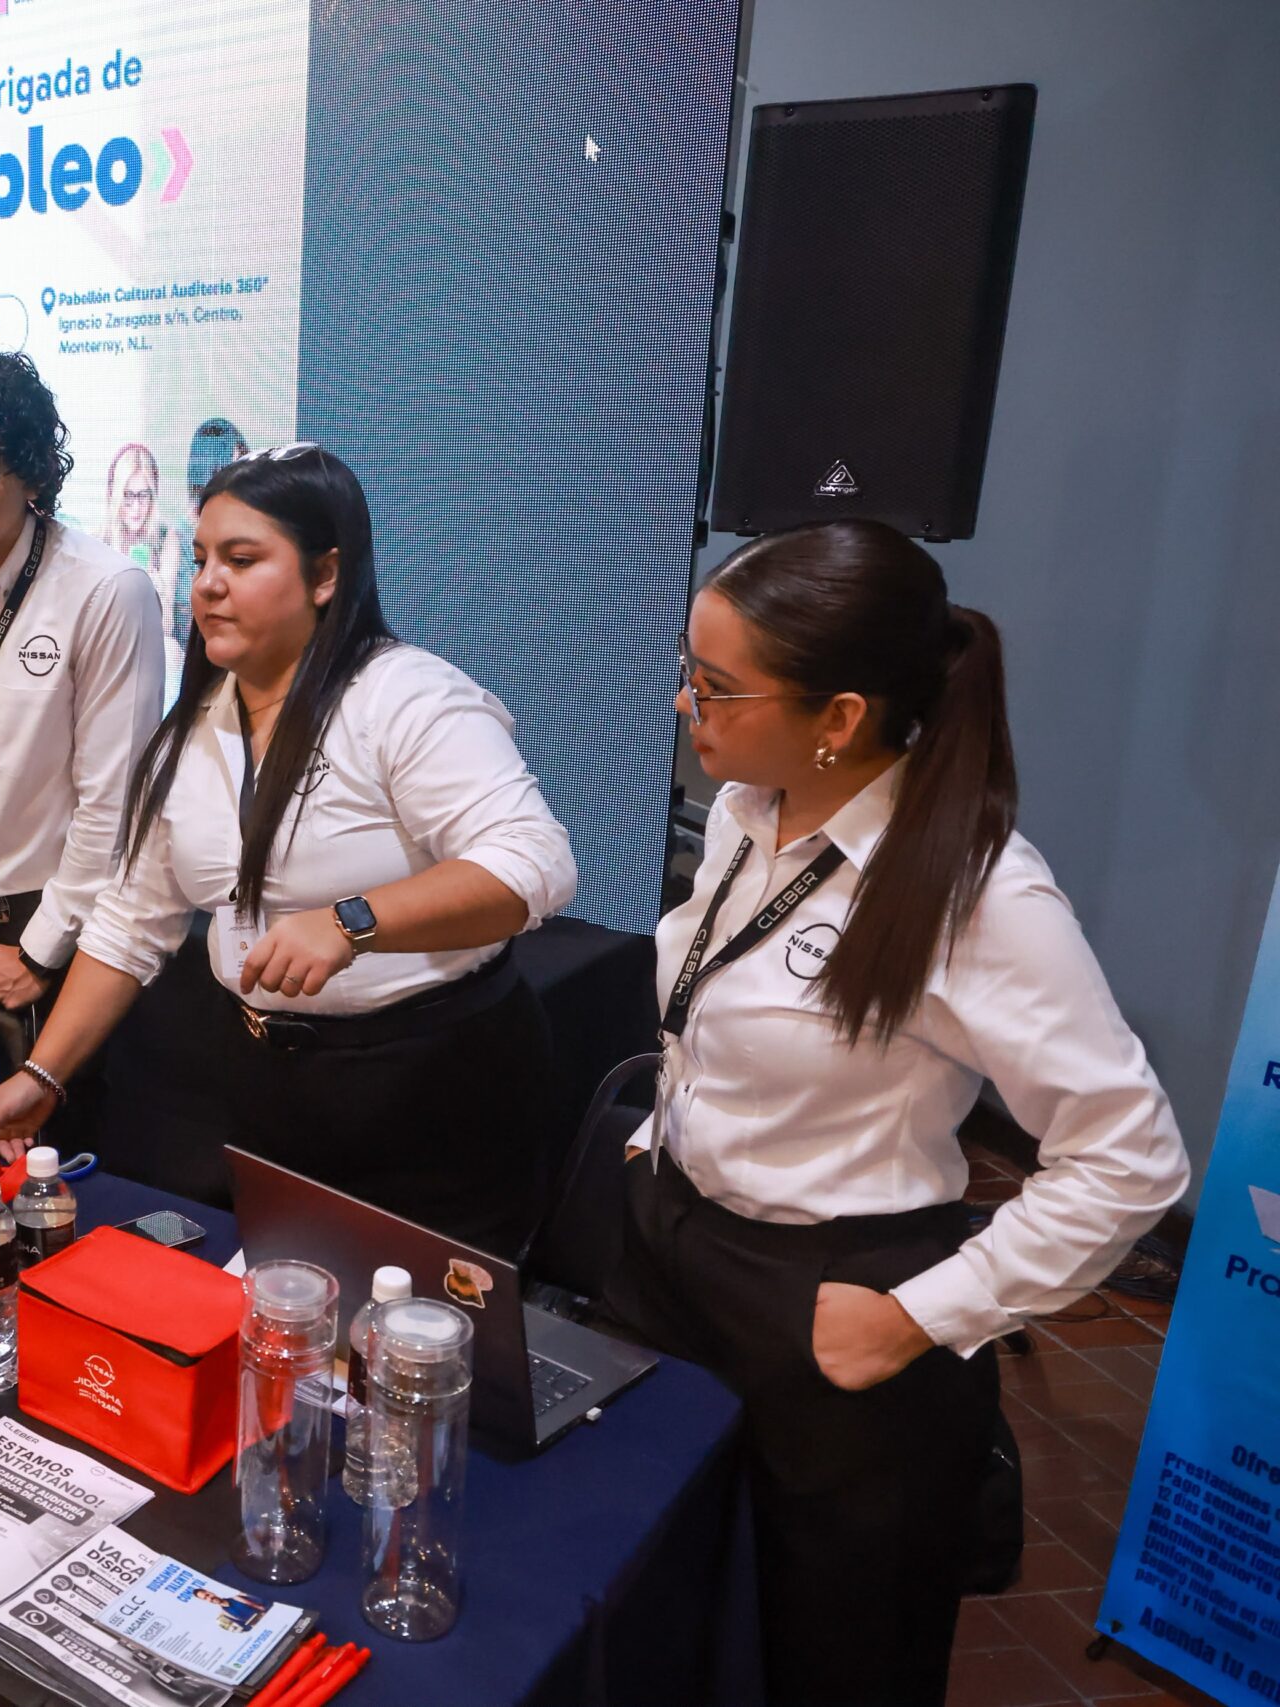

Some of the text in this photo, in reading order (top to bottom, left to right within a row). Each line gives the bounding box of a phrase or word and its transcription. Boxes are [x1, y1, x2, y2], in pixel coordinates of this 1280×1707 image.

[103, 49, 142, 90] de
[59, 288, 110, 307] Pabellón
[115, 283, 166, 302] Cultural
[170, 278, 233, 299] Auditorio
[59, 314, 102, 333] Ignacio
[106, 312, 161, 330] Zaragoza
[18, 651, 61, 660] NISSAN
[757, 871, 818, 930] CLEBER
[787, 935, 827, 960] NISS
[3, 1421, 40, 1444] CLEBER
[0, 1492, 15, 1506] para
[24, 1480, 39, 1493] DE
[36, 1486, 87, 1518] AUDITORÍA
[1164, 1451, 1271, 1515] Prestaciones
[21, 1489, 35, 1502] DE
[33, 1496, 77, 1521] CALIDAD
[1158, 1485, 1172, 1499] 12
[1173, 1493, 1200, 1515] días
[1200, 1508, 1217, 1525] de
[1161, 1468, 1271, 1535] Pago semanal
[1152, 1502, 1171, 1521] No
[1174, 1514, 1226, 1551] semana
[1144, 1535, 1216, 1584] Uniforme
[1208, 1551, 1273, 1596] Banorte
[146, 1563, 181, 1592] BUSCAMOS
[165, 1570, 194, 1594] TALENTO
[120, 1595, 147, 1616] CLC
[125, 1609, 155, 1635] VACANTE
[53, 1634, 132, 1684] 8122578689
[1140, 1606, 1216, 1665] Agenda
[1221, 1651, 1244, 1680] tu
